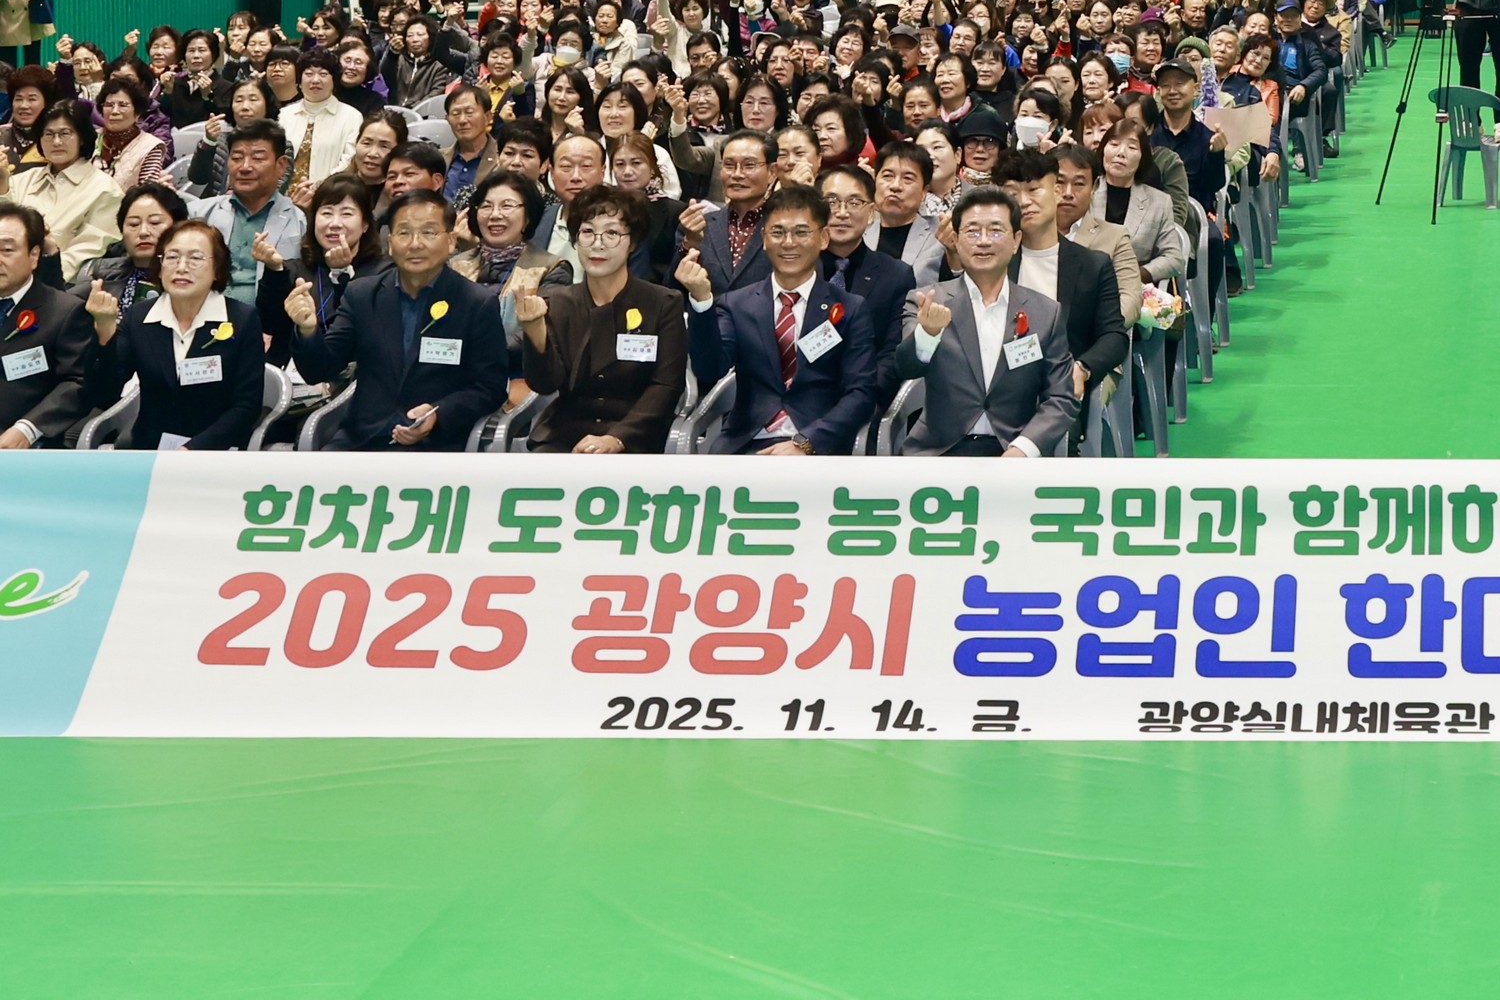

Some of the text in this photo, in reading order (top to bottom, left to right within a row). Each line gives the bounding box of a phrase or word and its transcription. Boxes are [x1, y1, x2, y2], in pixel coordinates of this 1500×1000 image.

[237, 484, 470, 553] 힘차게
[489, 486, 800, 555] 도약하는
[828, 486, 999, 564] 농업,
[1030, 486, 1266, 556] 국민과
[198, 572, 536, 672] 2025
[571, 573, 917, 677] 광양시
[953, 574, 1297, 679] 농업인
[600, 696, 1496, 734] 2025. 11. 14. 금. 광양실내체육관
